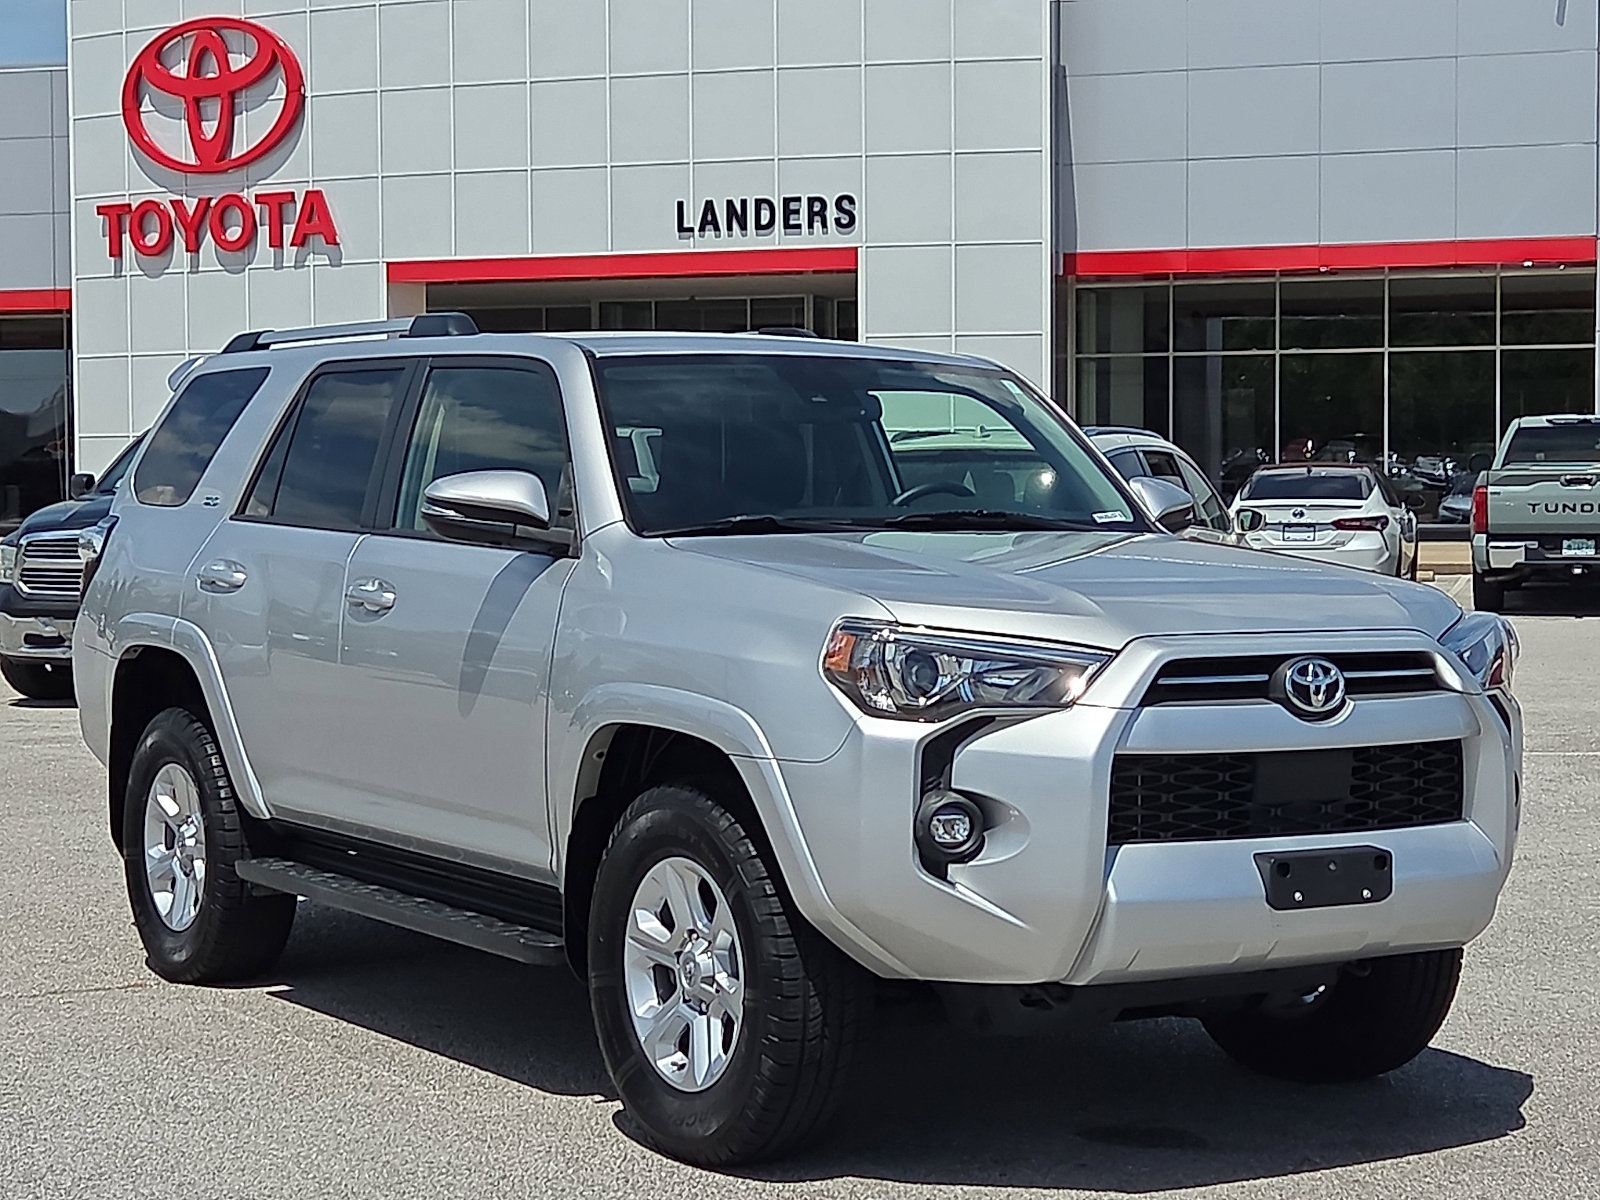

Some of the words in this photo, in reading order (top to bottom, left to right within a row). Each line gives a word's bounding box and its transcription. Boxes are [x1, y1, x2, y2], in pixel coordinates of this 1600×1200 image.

[97, 190, 341, 257] TOYOTA
[676, 194, 857, 233] LANDERS
[1527, 502, 1600, 514] TUND
